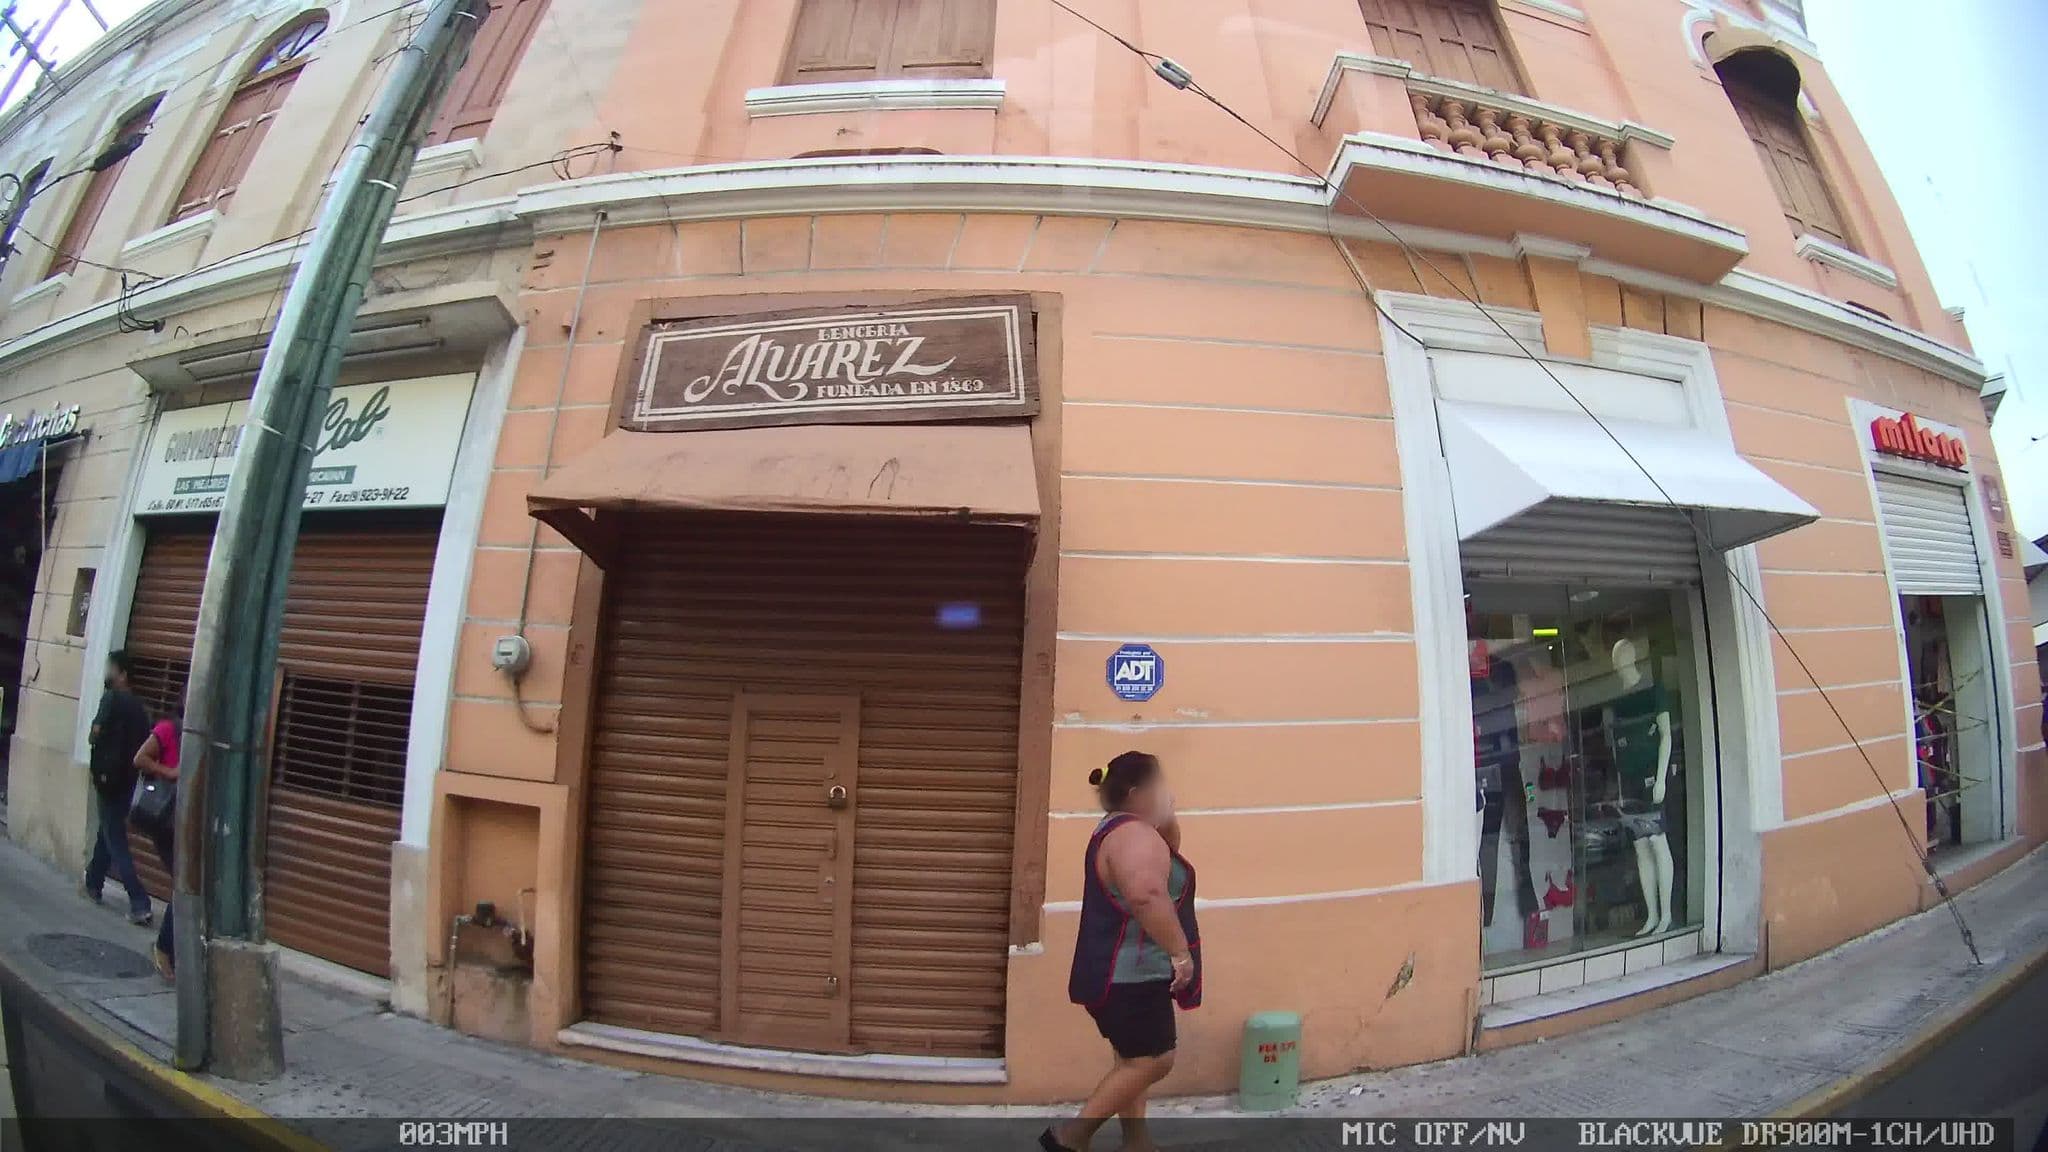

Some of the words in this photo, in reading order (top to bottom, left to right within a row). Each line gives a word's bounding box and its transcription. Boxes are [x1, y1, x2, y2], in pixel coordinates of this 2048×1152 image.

[683, 334, 957, 402] ALVAREZ
[816, 382, 905, 398] FUNDADA
[910, 380, 938, 394] EN
[1871, 412, 1968, 468] milano
[1116, 660, 1154, 681] ADT
